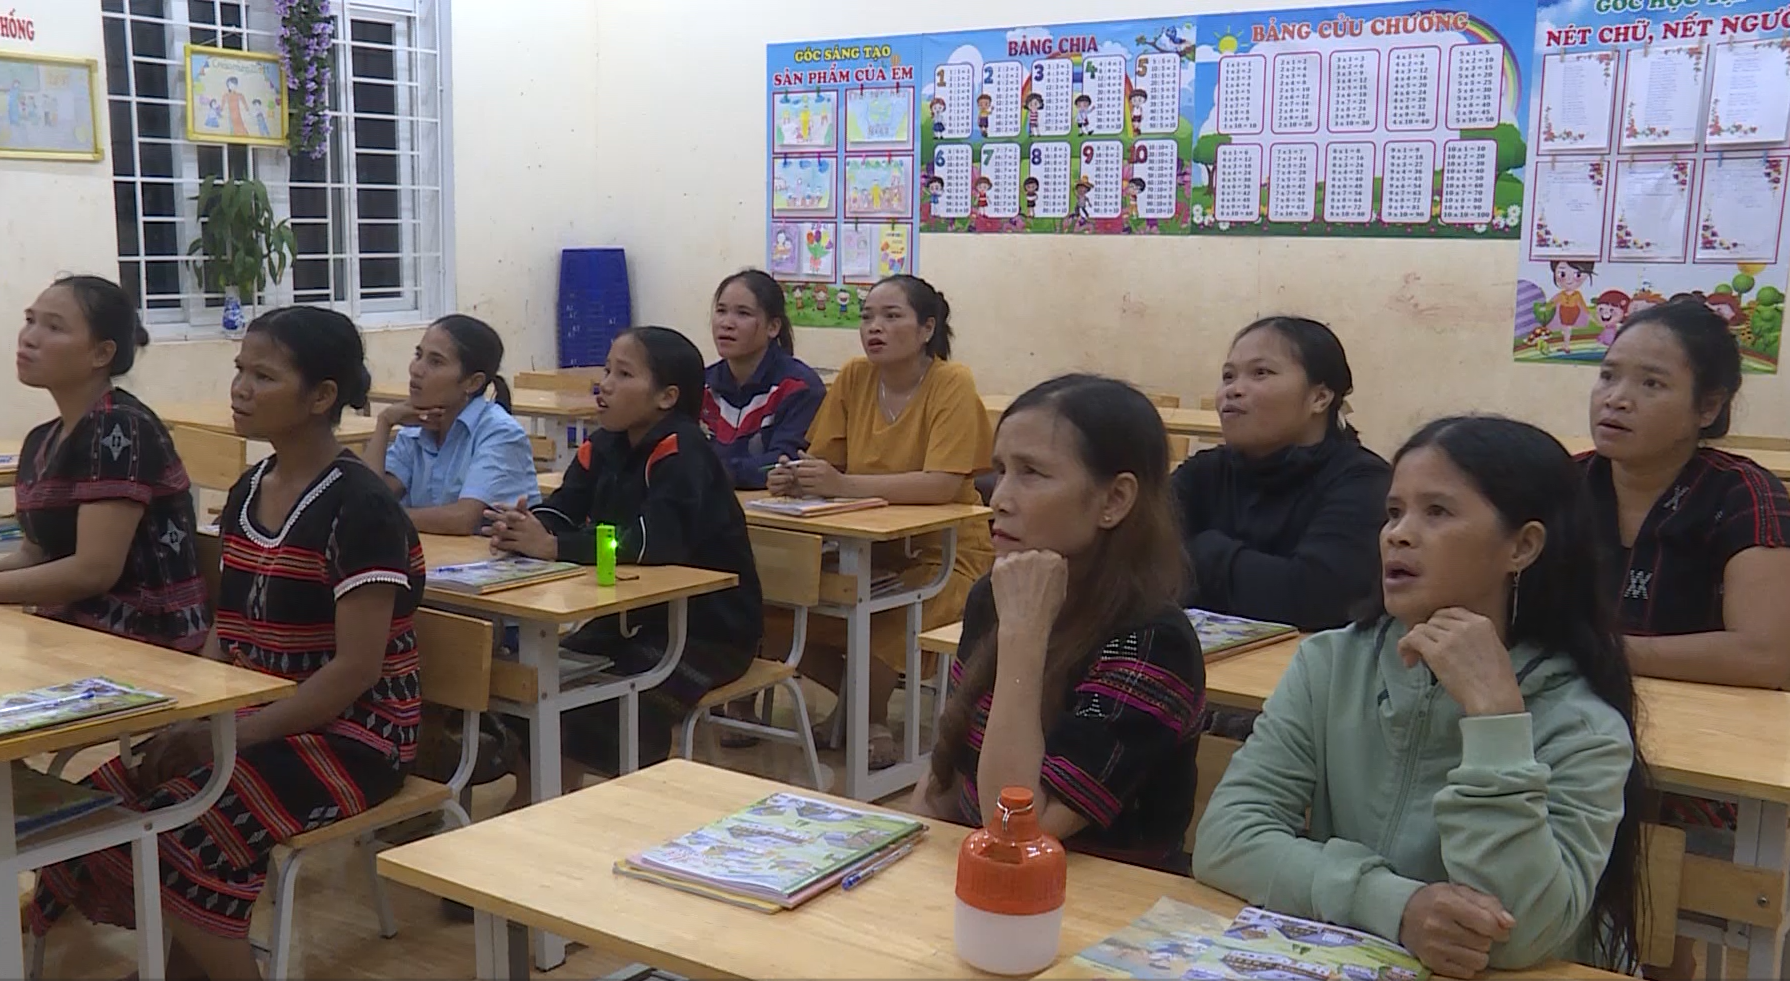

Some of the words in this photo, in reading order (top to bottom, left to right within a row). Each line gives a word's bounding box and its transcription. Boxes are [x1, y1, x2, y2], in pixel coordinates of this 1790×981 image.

[1251, 17, 1311, 42] BẢNG
[1318, 13, 1364, 38] CỬU
[1371, 12, 1469, 35] CHƯƠNG
[1545, 24, 1592, 47] NÉT
[1598, 19, 1654, 45] CHỮ,
[1661, 12, 1713, 40] NẾT
[794, 46, 821, 62] GÓC
[824, 43, 860, 60] SÁNG
[863, 45, 891, 62] TẠO
[1008, 34, 1053, 56] BẢNG
[1058, 36, 1099, 53] CHIA
[774, 68, 803, 86] SẢN
[808, 63, 850, 84] PHẨM
[854, 64, 887, 82] CỦA
[892, 66, 914, 80] EM
[983, 66, 994, 84] 2
[1034, 64, 1044, 81] 3
[1085, 61, 1098, 79] 4
[1136, 58, 1149, 77] 5
[937, 69, 947, 87] 1
[935, 150, 945, 167] 6
[983, 149, 994, 166] 7
[1031, 148, 1042, 165] 8
[1083, 145, 1094, 164] 9
[1128, 145, 1148, 164] 10
